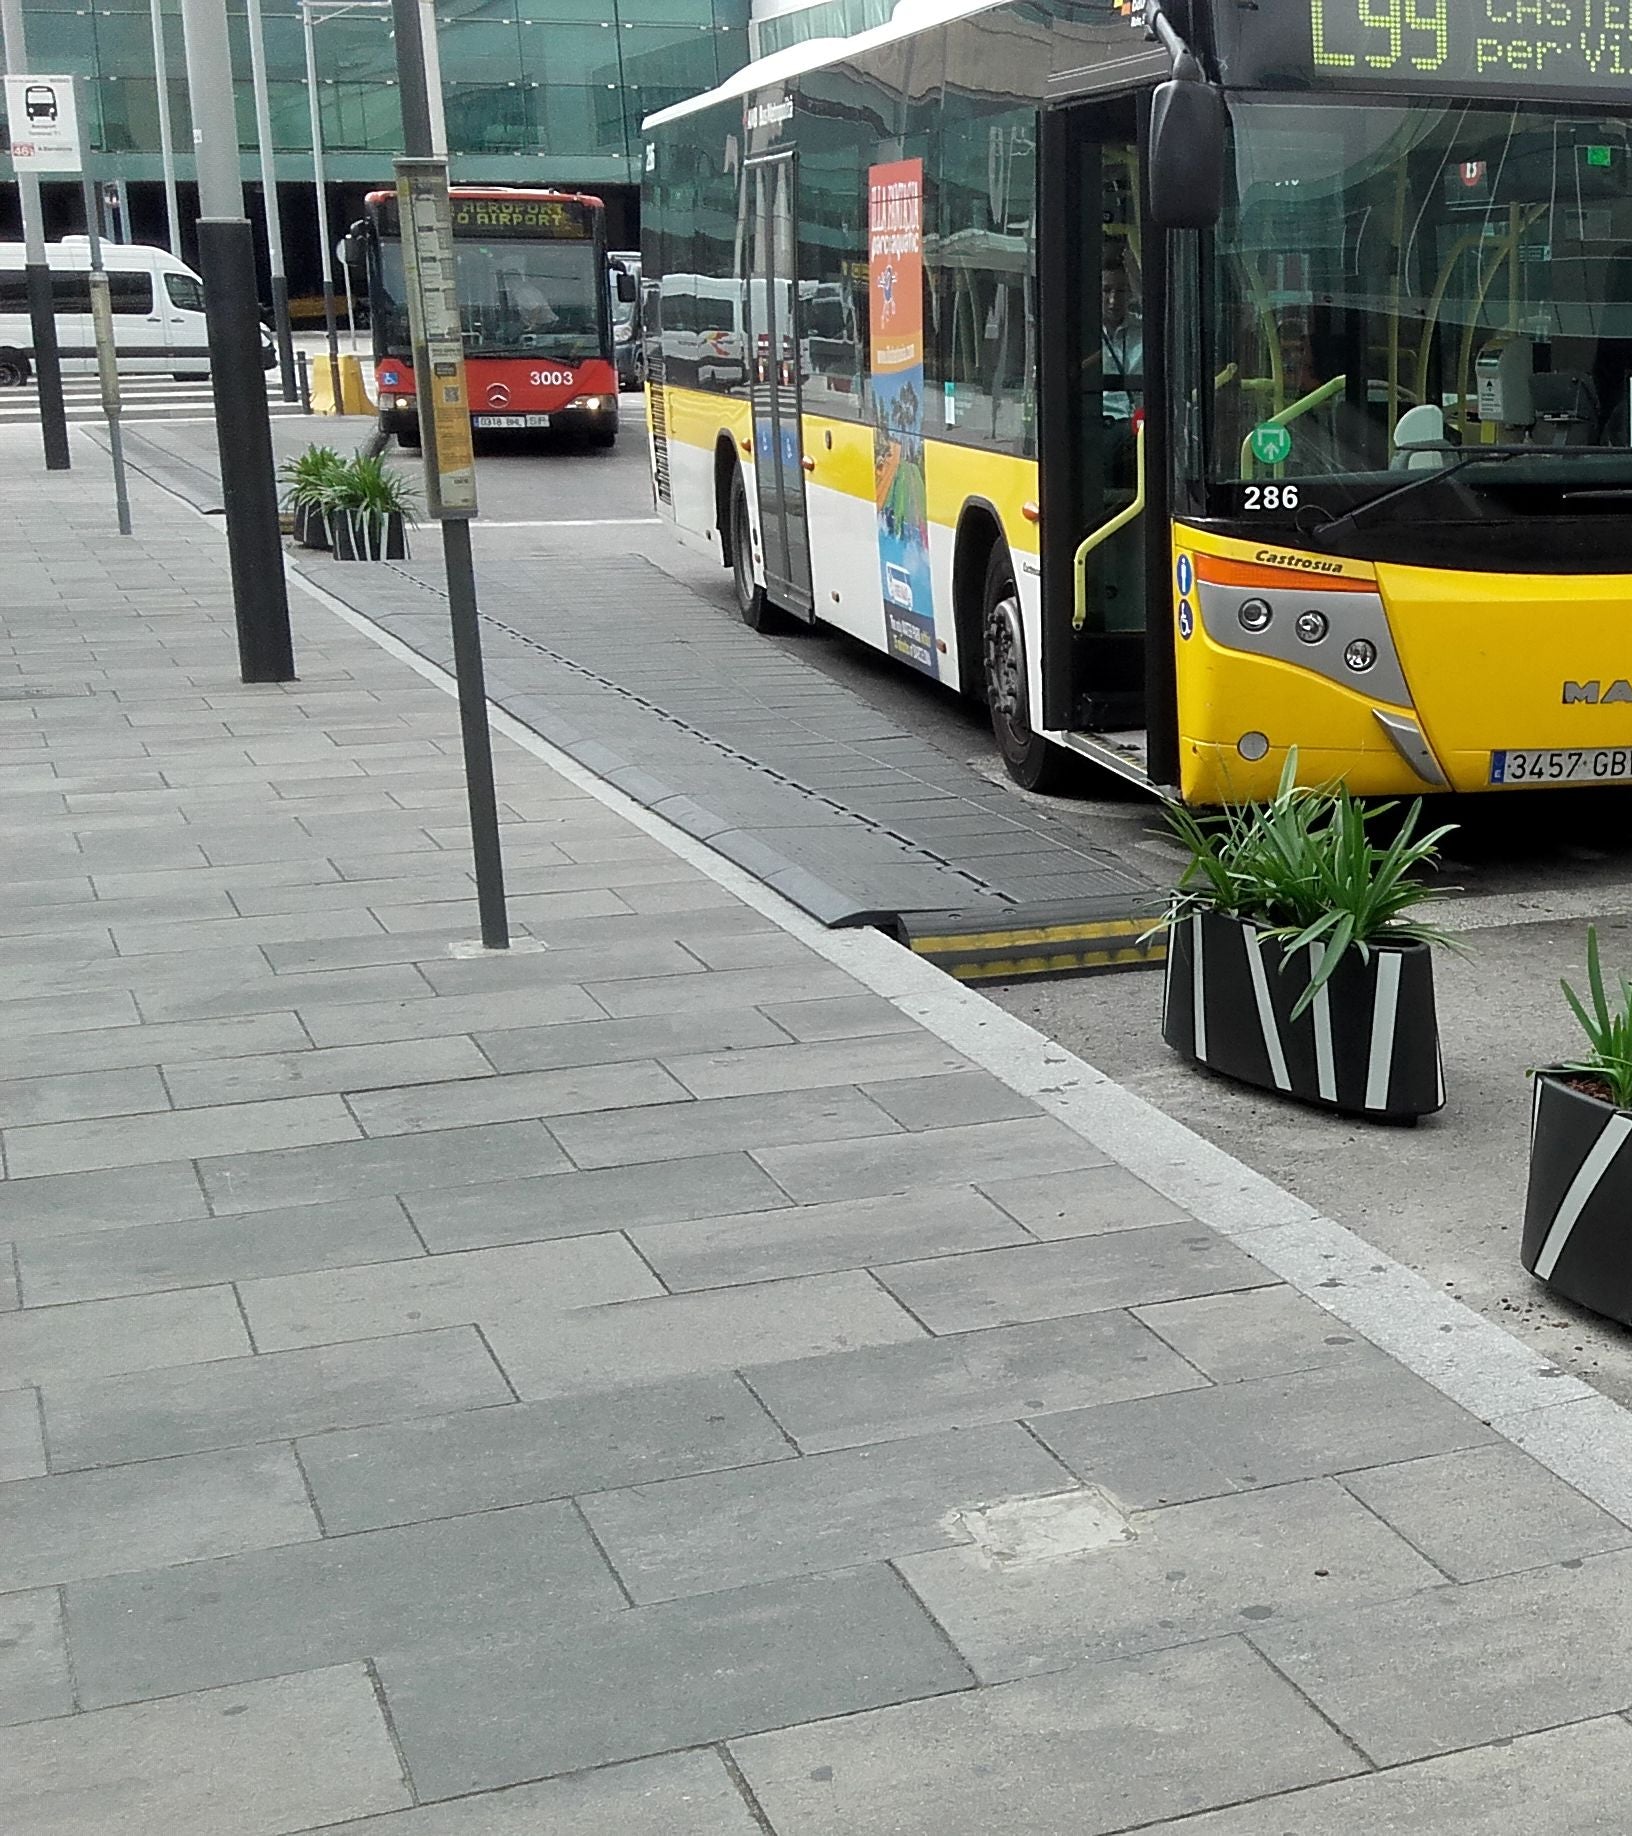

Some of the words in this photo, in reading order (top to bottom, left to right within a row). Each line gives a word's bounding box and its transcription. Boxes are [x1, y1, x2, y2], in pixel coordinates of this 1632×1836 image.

[1310, 0, 1448, 71] L99
[1476, 38, 1562, 74] per
[477, 213, 563, 226] AIRPORT
[530, 371, 574, 386] 3003
[1244, 485, 1299, 510] 286
[1255, 550, 1344, 573] Castrosua
[1510, 752, 1583, 779] 3457
